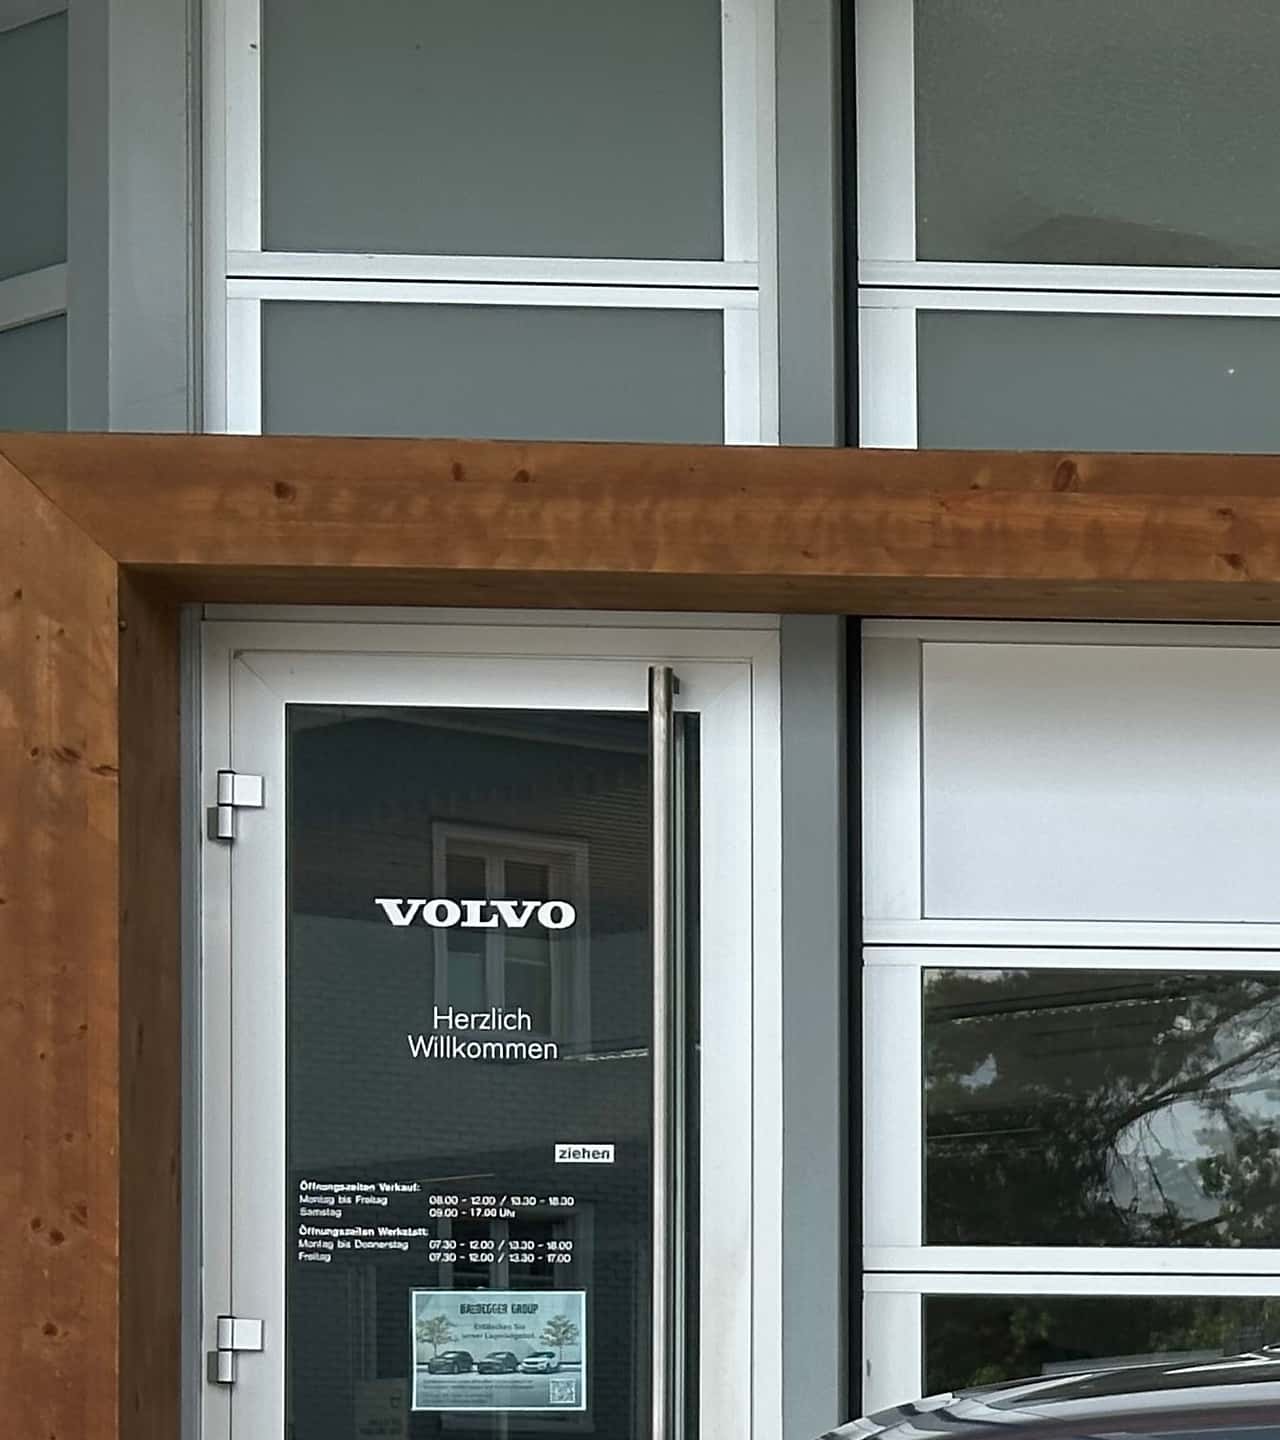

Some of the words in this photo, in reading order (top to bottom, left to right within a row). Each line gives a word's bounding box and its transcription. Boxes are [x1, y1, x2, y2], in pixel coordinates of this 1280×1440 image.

[375, 898, 576, 929] VOLVO
[433, 1006, 532, 1031] Herzlich
[407, 1035, 559, 1060] Willkommen
[559, 1147, 610, 1160] ziehen
